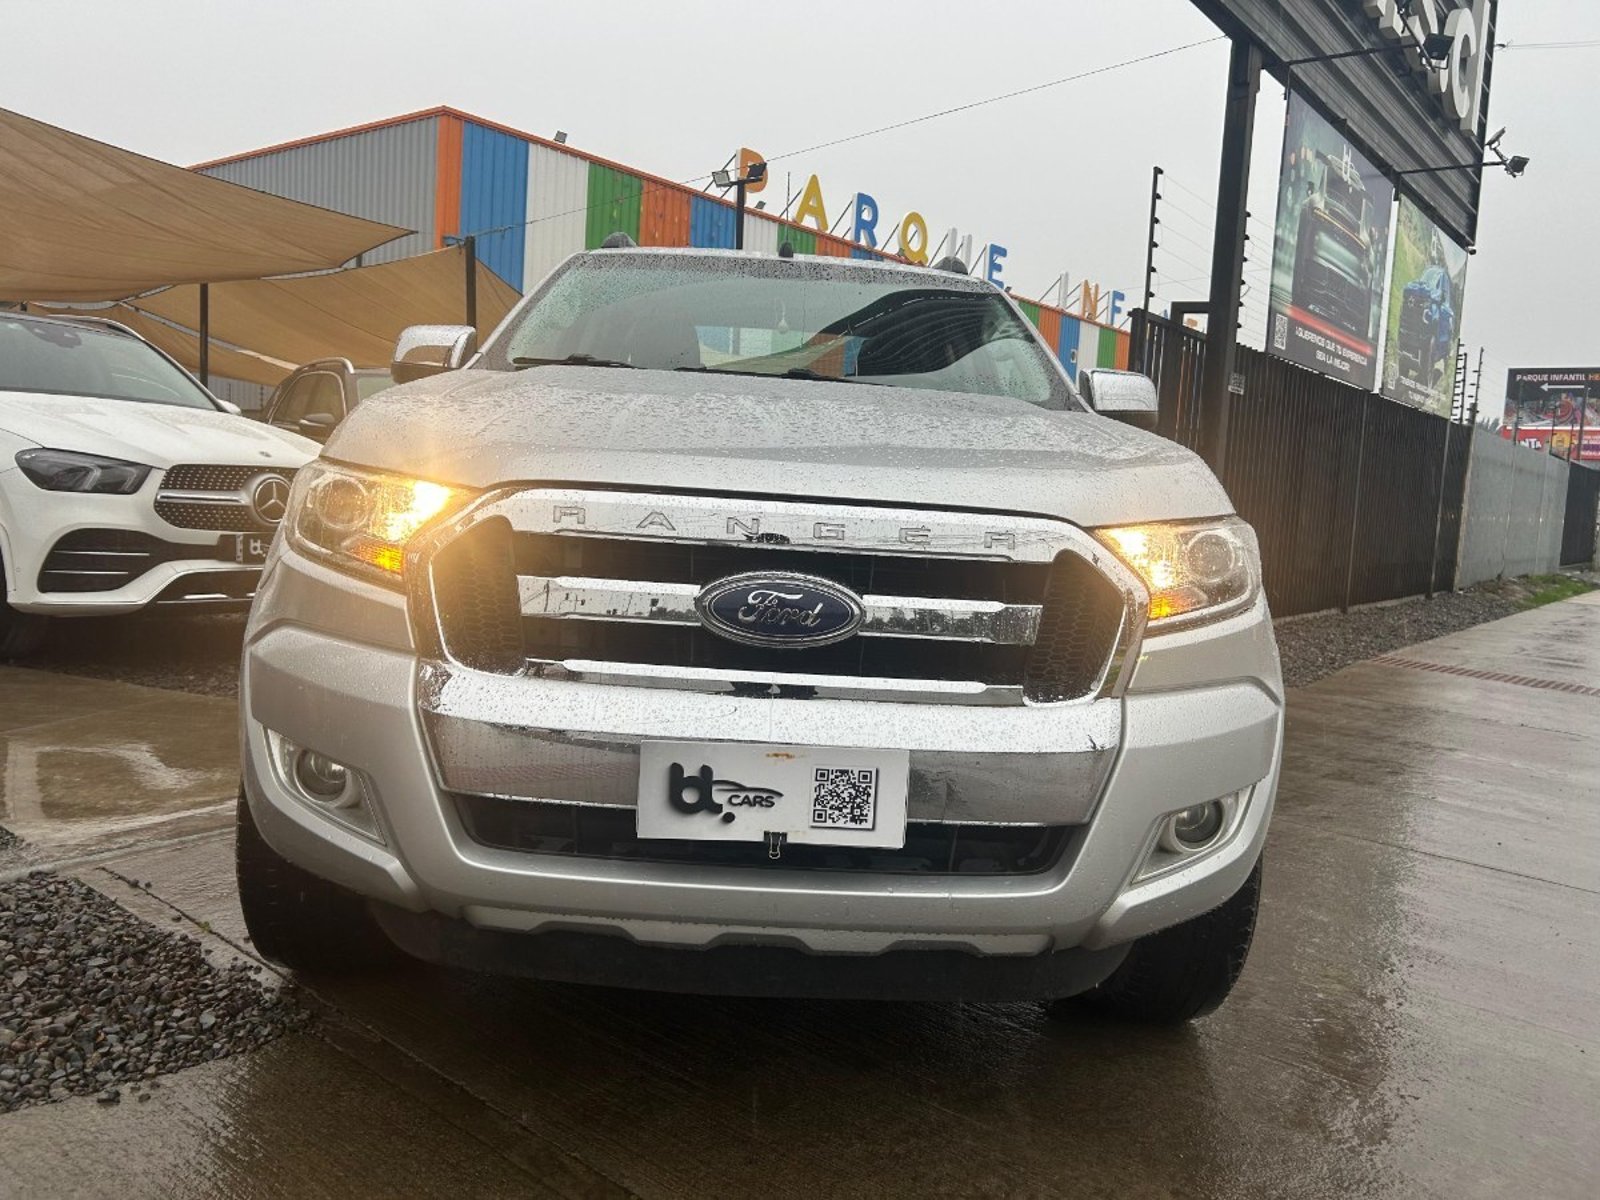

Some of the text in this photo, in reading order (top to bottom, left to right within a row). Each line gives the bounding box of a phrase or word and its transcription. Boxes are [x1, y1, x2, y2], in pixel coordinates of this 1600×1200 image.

[735, 147, 1008, 289] PARQUE
[1516, 373, 1549, 382] PARQUE
[1550, 373, 1585, 381] INFANTIL
[553, 504, 1015, 550] RANGER
[738, 589, 824, 628] Ford
[728, 794, 776, 808] CARS
